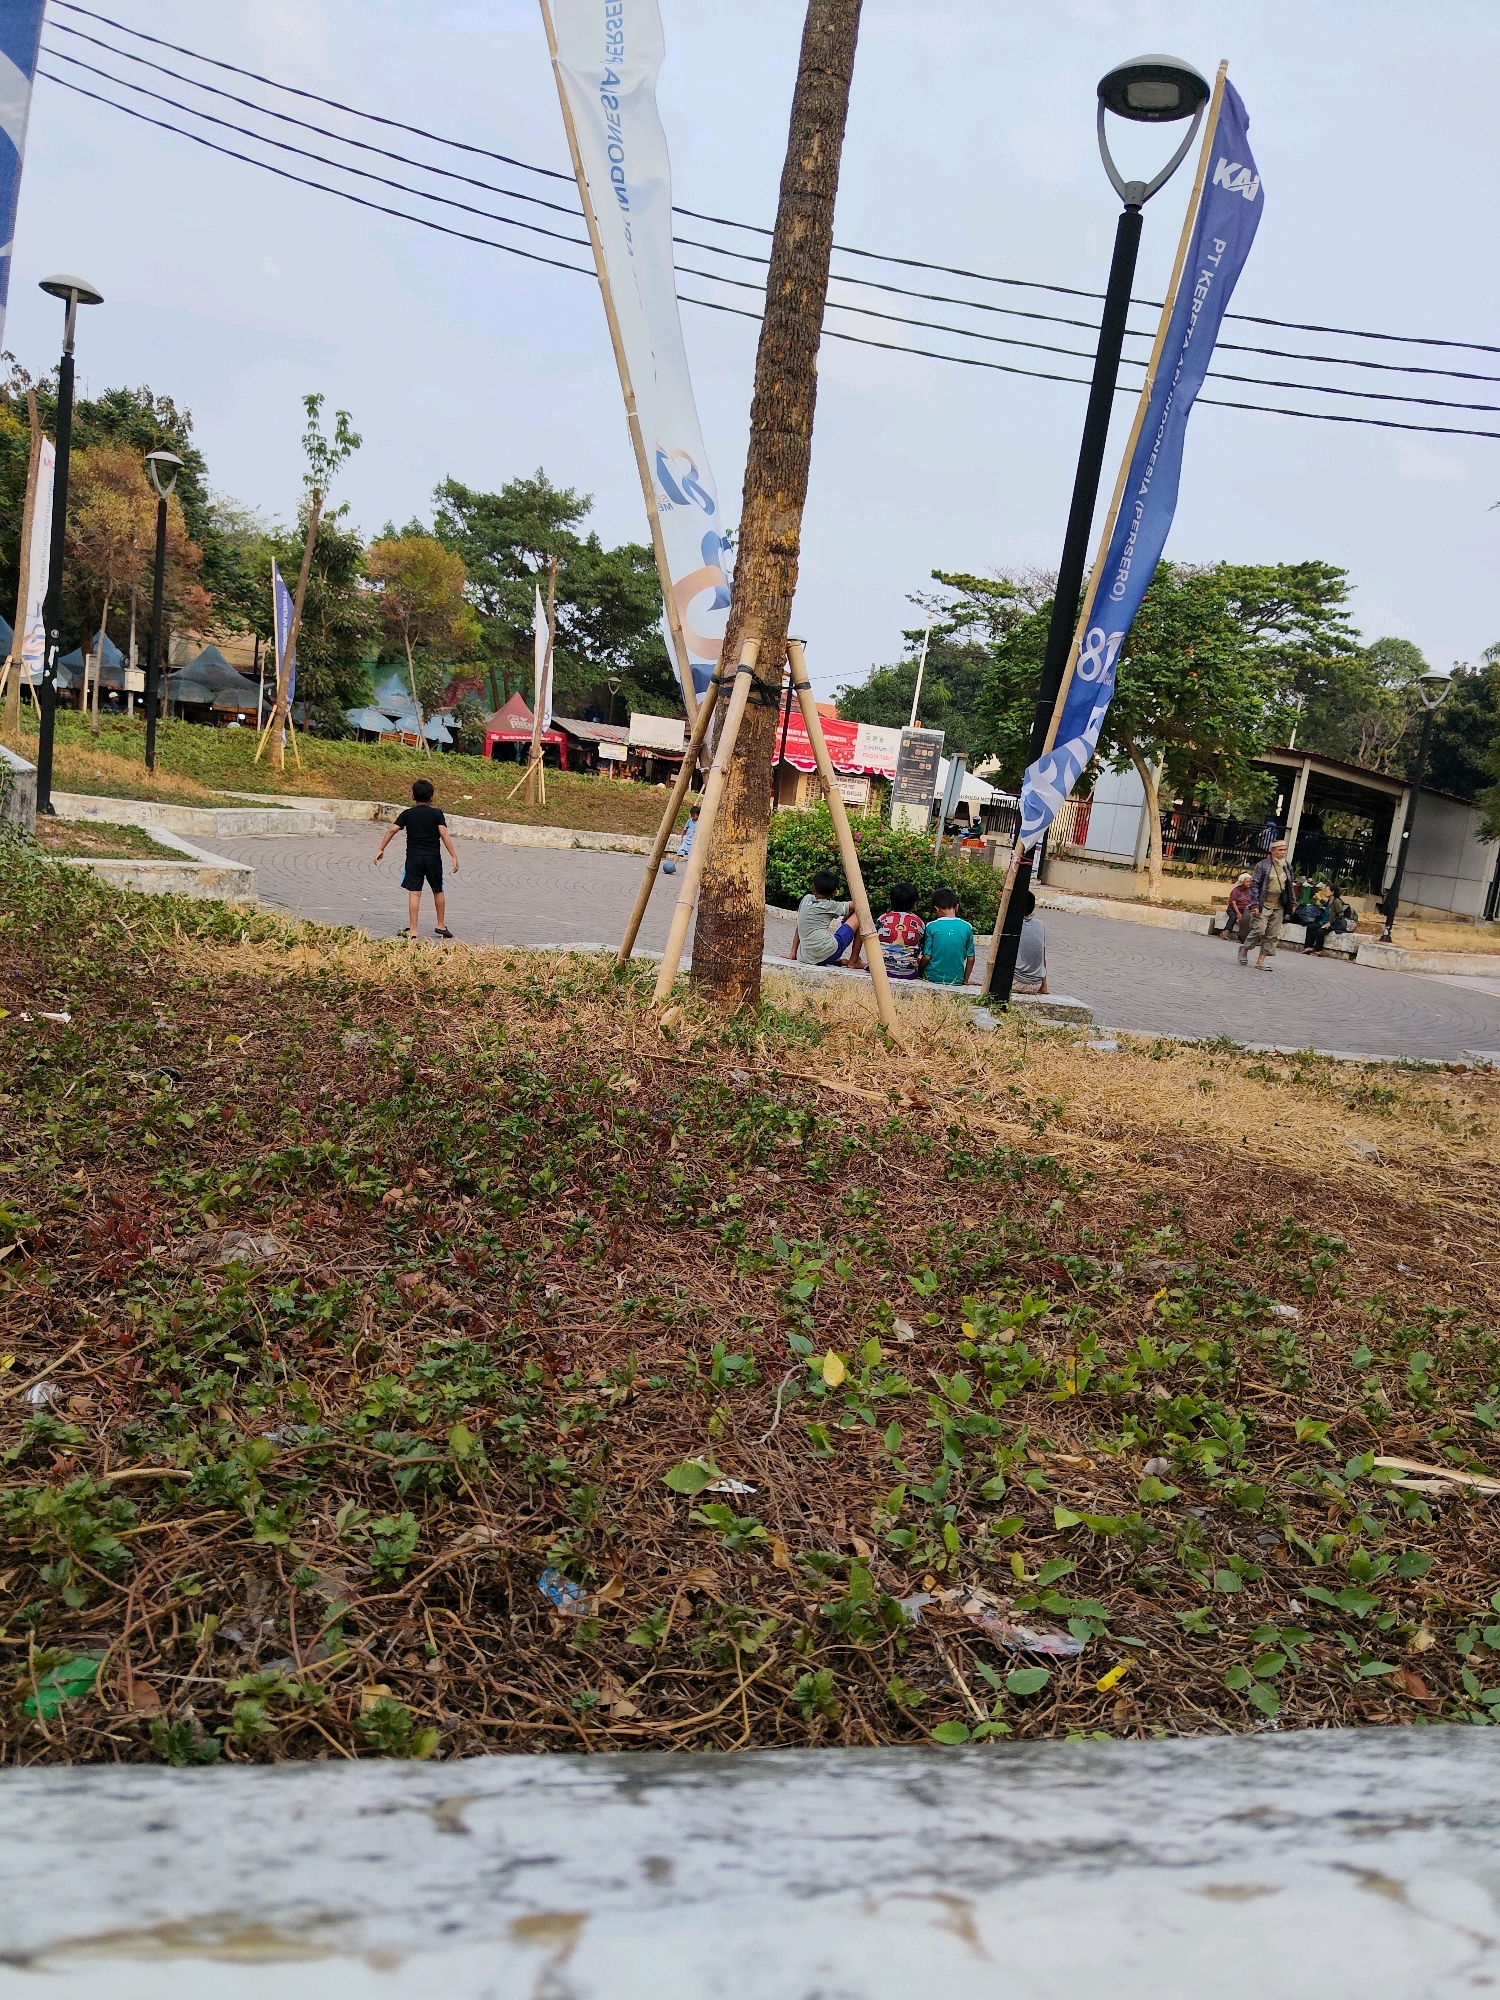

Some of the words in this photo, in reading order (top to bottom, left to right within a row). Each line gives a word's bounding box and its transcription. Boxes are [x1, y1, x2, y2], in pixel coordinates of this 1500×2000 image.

[1212, 157, 1261, 202] KAI
[1206, 237, 1227, 268] PT
[1182, 269, 1215, 350] KERETA
[1138, 391, 1174, 495] INDONESIA
[1108, 499, 1145, 602] (PERSERO)
